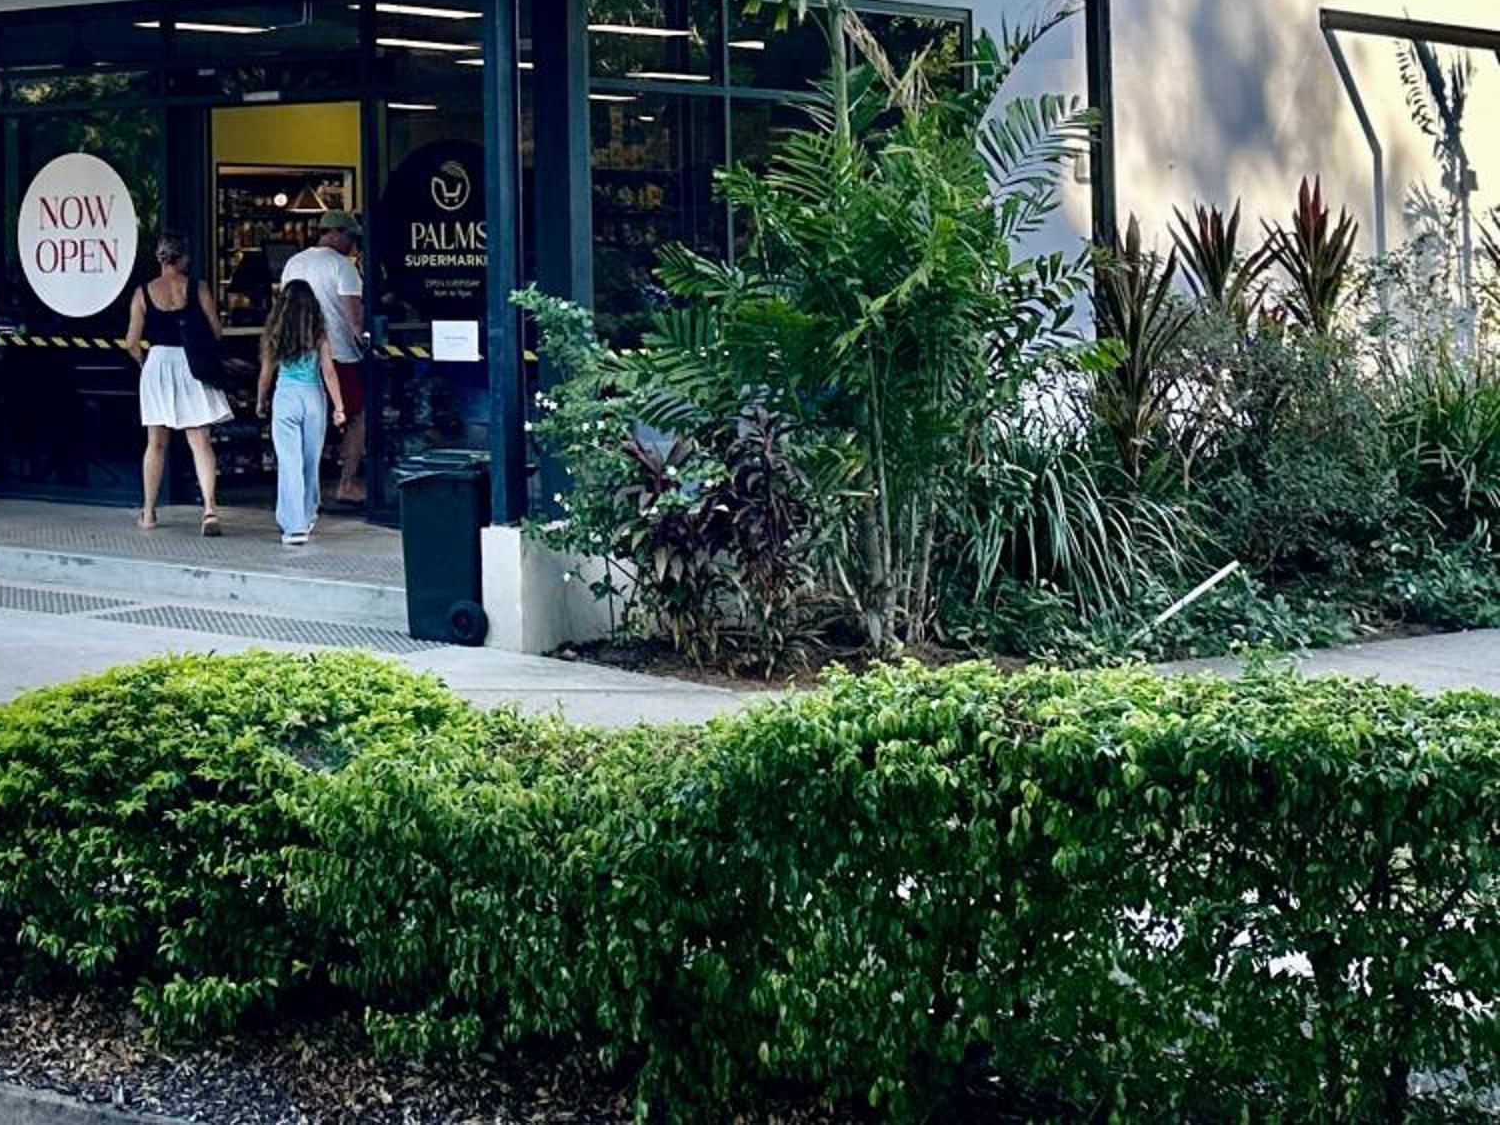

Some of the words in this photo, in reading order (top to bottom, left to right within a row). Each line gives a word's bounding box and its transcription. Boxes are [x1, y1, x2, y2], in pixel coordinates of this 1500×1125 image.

[39, 194, 115, 230] NOW
[411, 221, 488, 250] PALMS
[35, 238, 119, 274] OPEN
